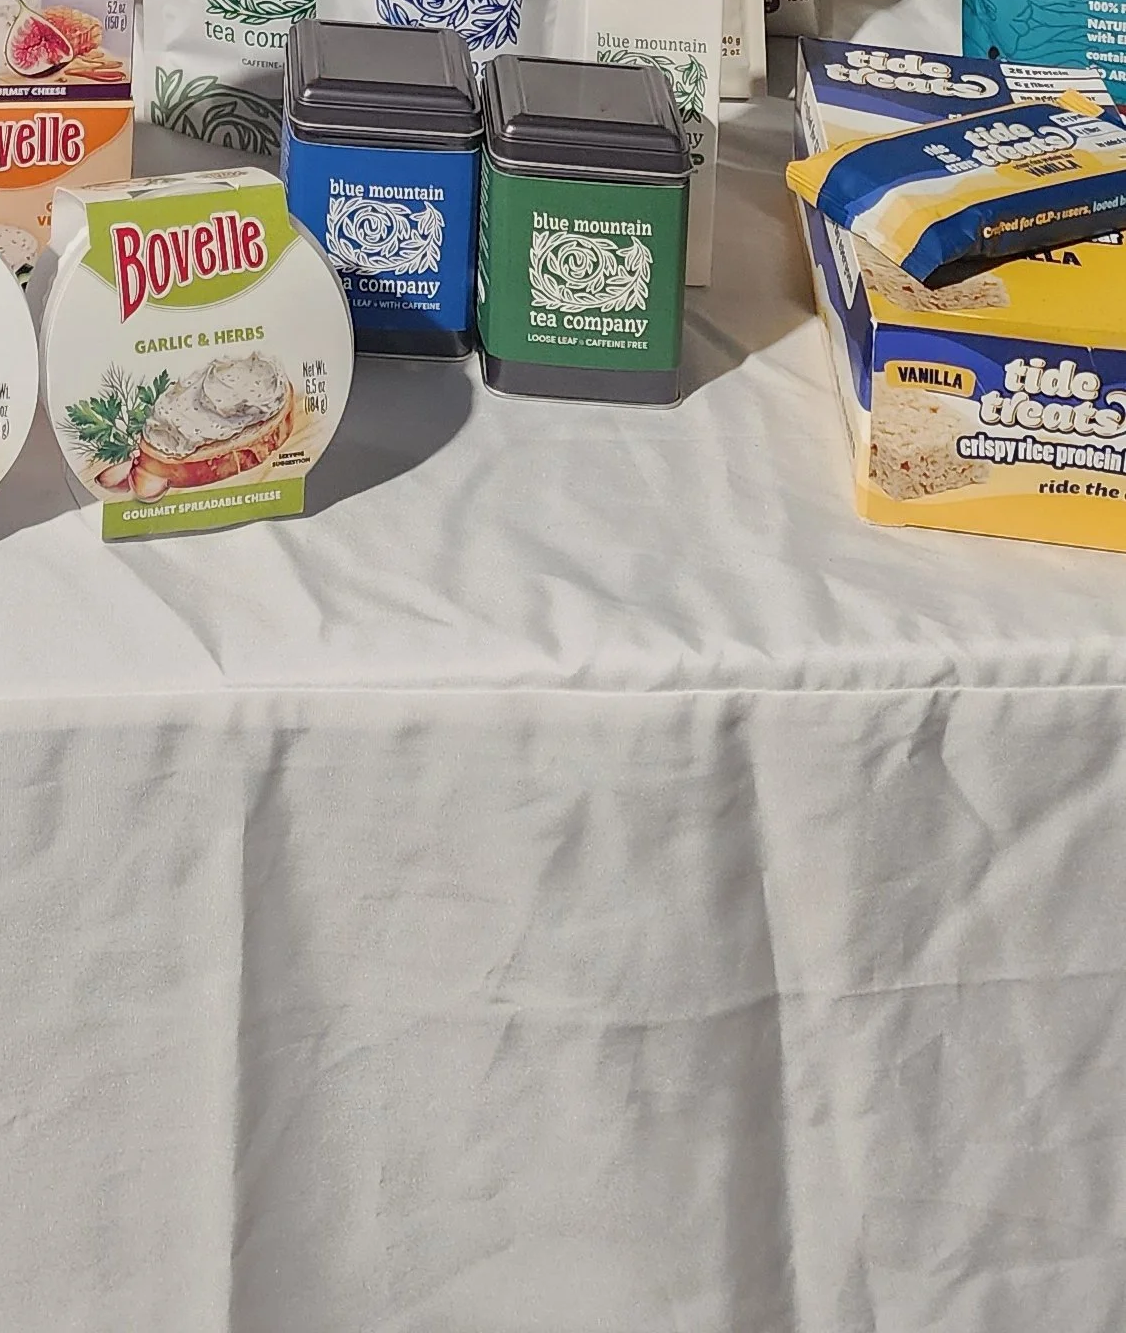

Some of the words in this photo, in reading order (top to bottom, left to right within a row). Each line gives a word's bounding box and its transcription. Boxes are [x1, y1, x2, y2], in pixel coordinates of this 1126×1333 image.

[1088, 0, 1119, 14] 100%
[205, 20, 236, 44] tea
[597, 32, 630, 48] blue
[635, 36, 707, 53] mountain
[734, 37, 741, 46] g
[1087, 32, 1116, 44] with
[845, 49, 952, 79] tide
[31, 87, 67, 97] CHEESE
[825, 62, 998, 98] treats
[963, 122, 1035, 147] tide
[972, 126, 1075, 167] treats
[1024, 159, 1082, 177] VANILLA
[329, 178, 364, 198] blue
[368, 182, 444, 201] mountain
[533, 212, 569, 232] blue
[574, 217, 653, 237] mountain
[983, 220, 1019, 238] Crafted
[1019, 216, 1034, 233] for
[1035, 212, 1061, 227] GLP-1
[1062, 205, 1091, 219] users,
[1092, 196, 1119, 213] loved
[112, 213, 268, 323] Bovelle
[358, 278, 441, 297] company
[352, 298, 374, 308] LEAF
[379, 300, 401, 310] WITH
[402, 301, 441, 311] CAFFEINE
[529, 309, 558, 328] tea
[563, 313, 649, 337] company
[134, 334, 193, 355] GARLIC
[198, 333, 210, 346] &
[214, 326, 265, 344] HERBS
[527, 334, 556, 344] LOOSE
[558, 335, 579, 345] LEAF
[585, 337, 626, 348] CAFFEINE
[627, 339, 649, 350] FREE
[898, 366, 963, 390] VANILLA
[1004, 358, 1101, 400] tide
[980, 390, 1124, 435] treats
[959, 435, 1017, 462] crispy
[1018, 438, 1055, 461] rice
[1056, 445, 1122, 472] protein
[1039, 480, 1081, 494] ride
[1086, 482, 1120, 499] the
[122, 505, 177, 521] GOURMET
[177, 496, 244, 513] SPREADABLE
[244, 490, 281, 504] CHEESE
